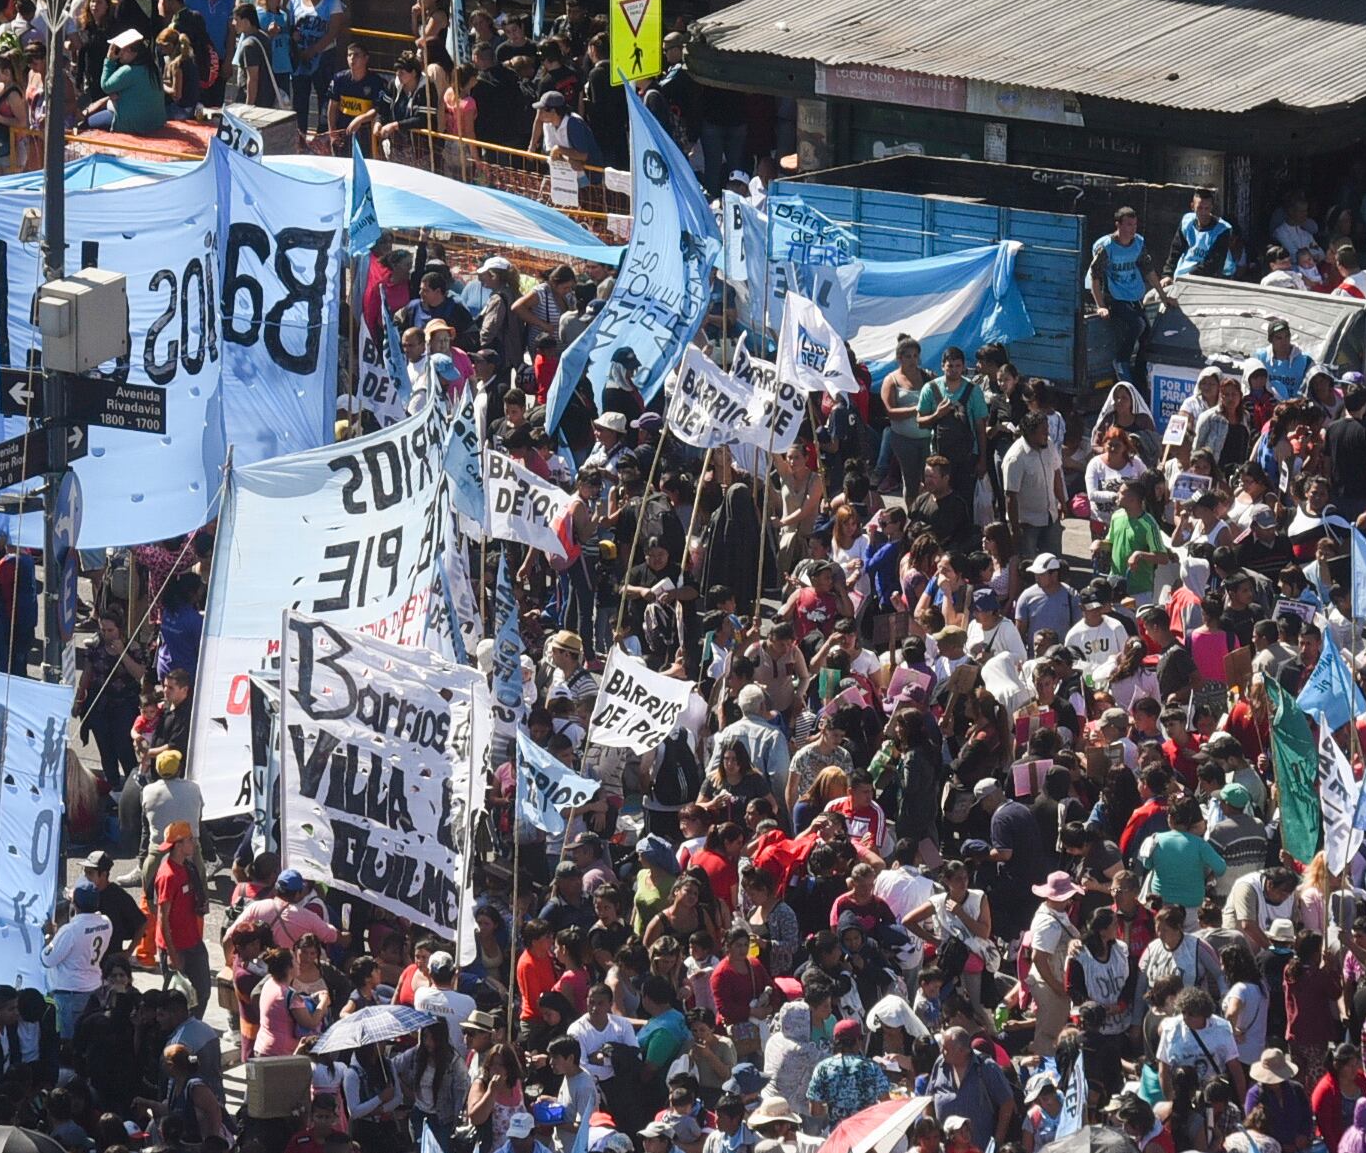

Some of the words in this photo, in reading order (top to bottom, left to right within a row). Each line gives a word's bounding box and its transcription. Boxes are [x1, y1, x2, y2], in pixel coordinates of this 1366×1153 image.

[835, 68, 895, 84] LOCUTORIO
[904, 76, 954, 92] INTERNET
[115, 386, 160, 402] Avenida
[1160, 379, 1181, 394] POR
[106, 398, 160, 415] Rivadavia
[99, 413, 124, 426] 1800
[135, 417, 160, 430] 1700
[287, 617, 450, 754] Barrios
[594, 703, 627, 730] DE
[629, 718, 666, 750] PIE
[287, 724, 418, 832] VILLA
